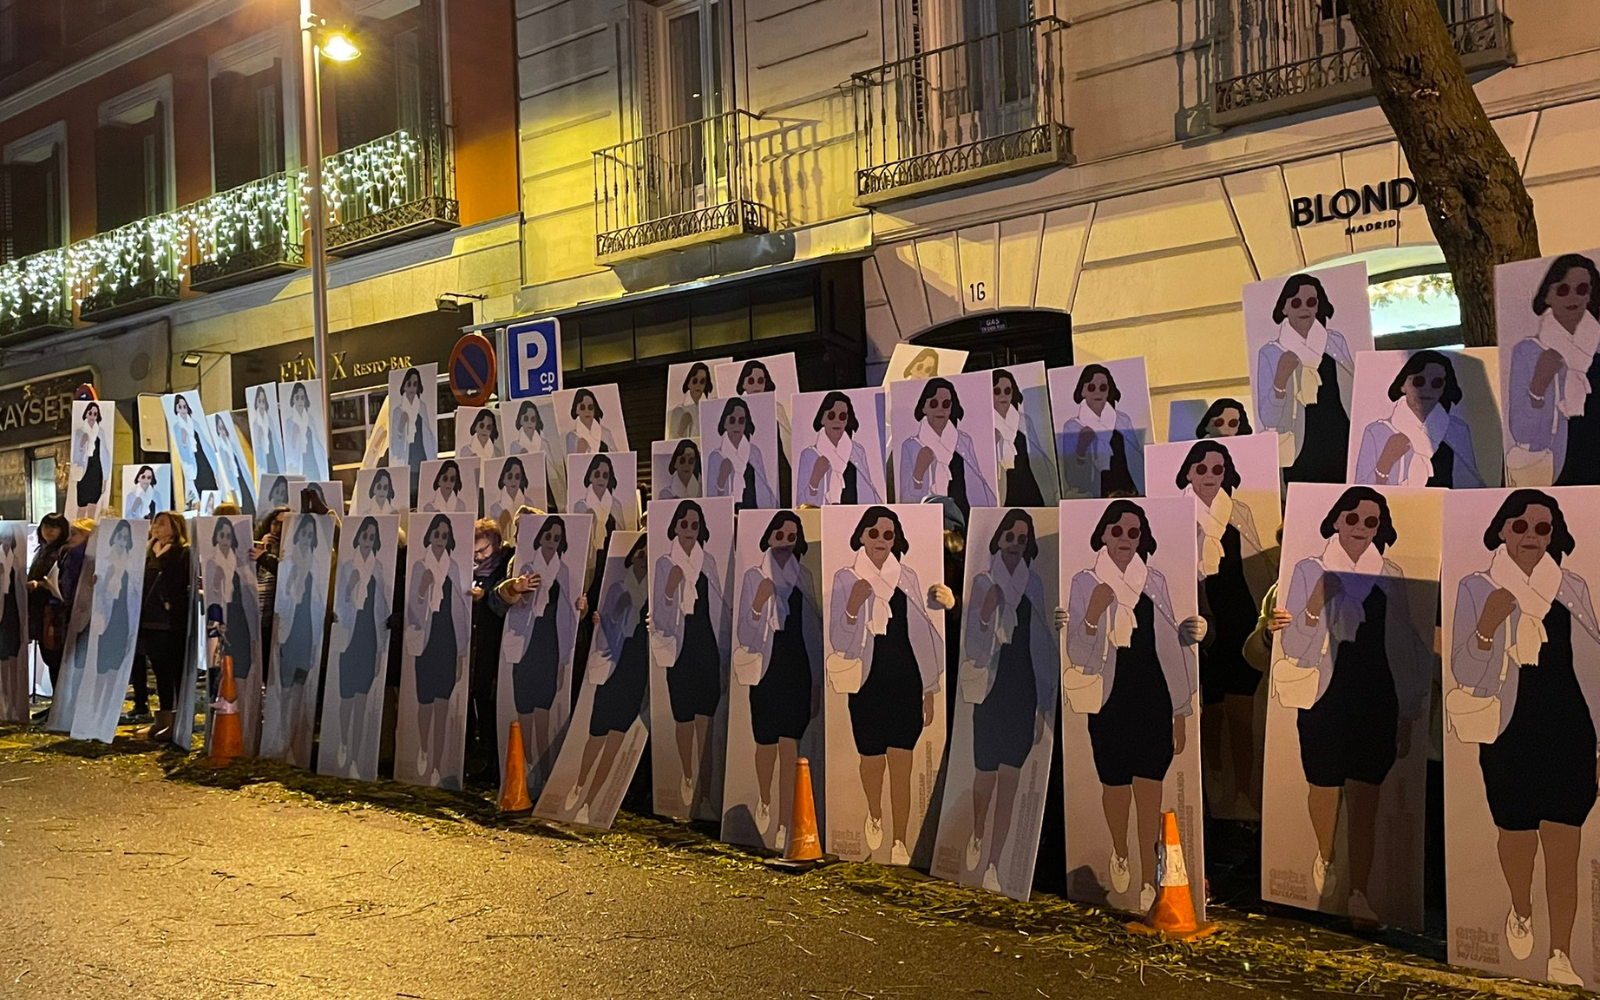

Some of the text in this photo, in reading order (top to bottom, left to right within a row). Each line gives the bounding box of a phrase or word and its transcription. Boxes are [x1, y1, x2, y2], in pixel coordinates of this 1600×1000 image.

[1291, 177, 1421, 229] BLOND
[1345, 219, 1396, 235] MADRID
[970, 282, 985, 302] 16
[279, 351, 347, 383] FÉNX
[517, 331, 548, 391] P
[540, 372, 555, 384] CD
[0, 391, 73, 432] AYSER
